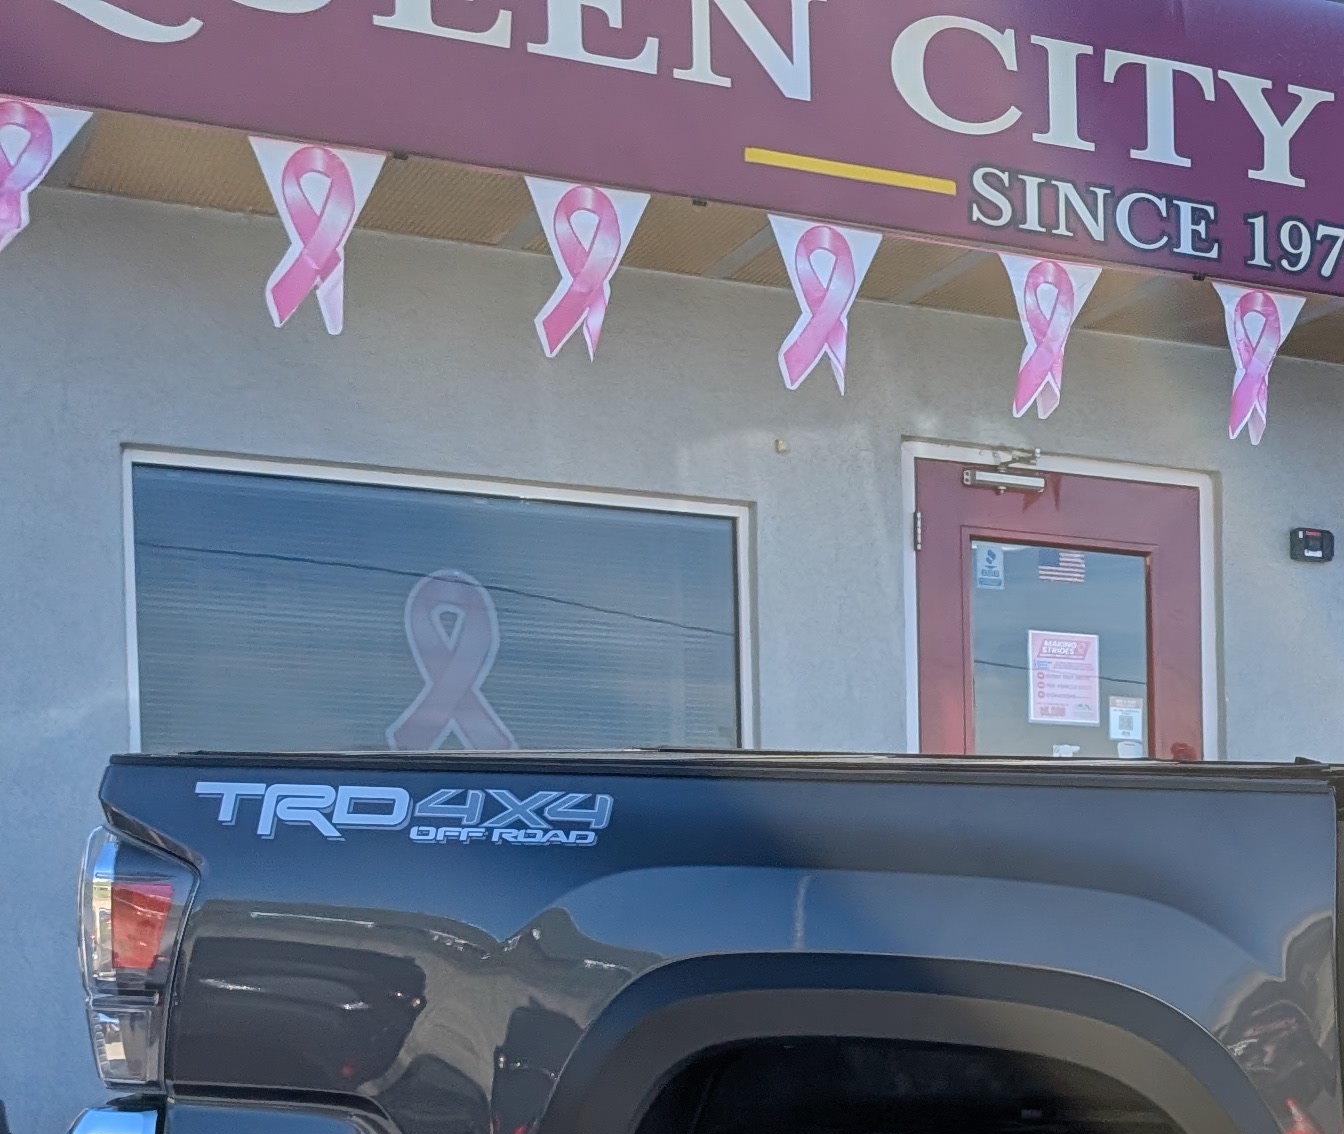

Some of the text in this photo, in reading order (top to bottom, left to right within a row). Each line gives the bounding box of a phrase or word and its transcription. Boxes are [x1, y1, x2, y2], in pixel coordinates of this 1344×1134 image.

[890, 14, 1335, 188] CITY
[971, 166, 1220, 260] SINCE
[194, 780, 412, 842] TRD
[408, 825, 486, 845] OFF
[490, 827, 600, 848] ROAD
